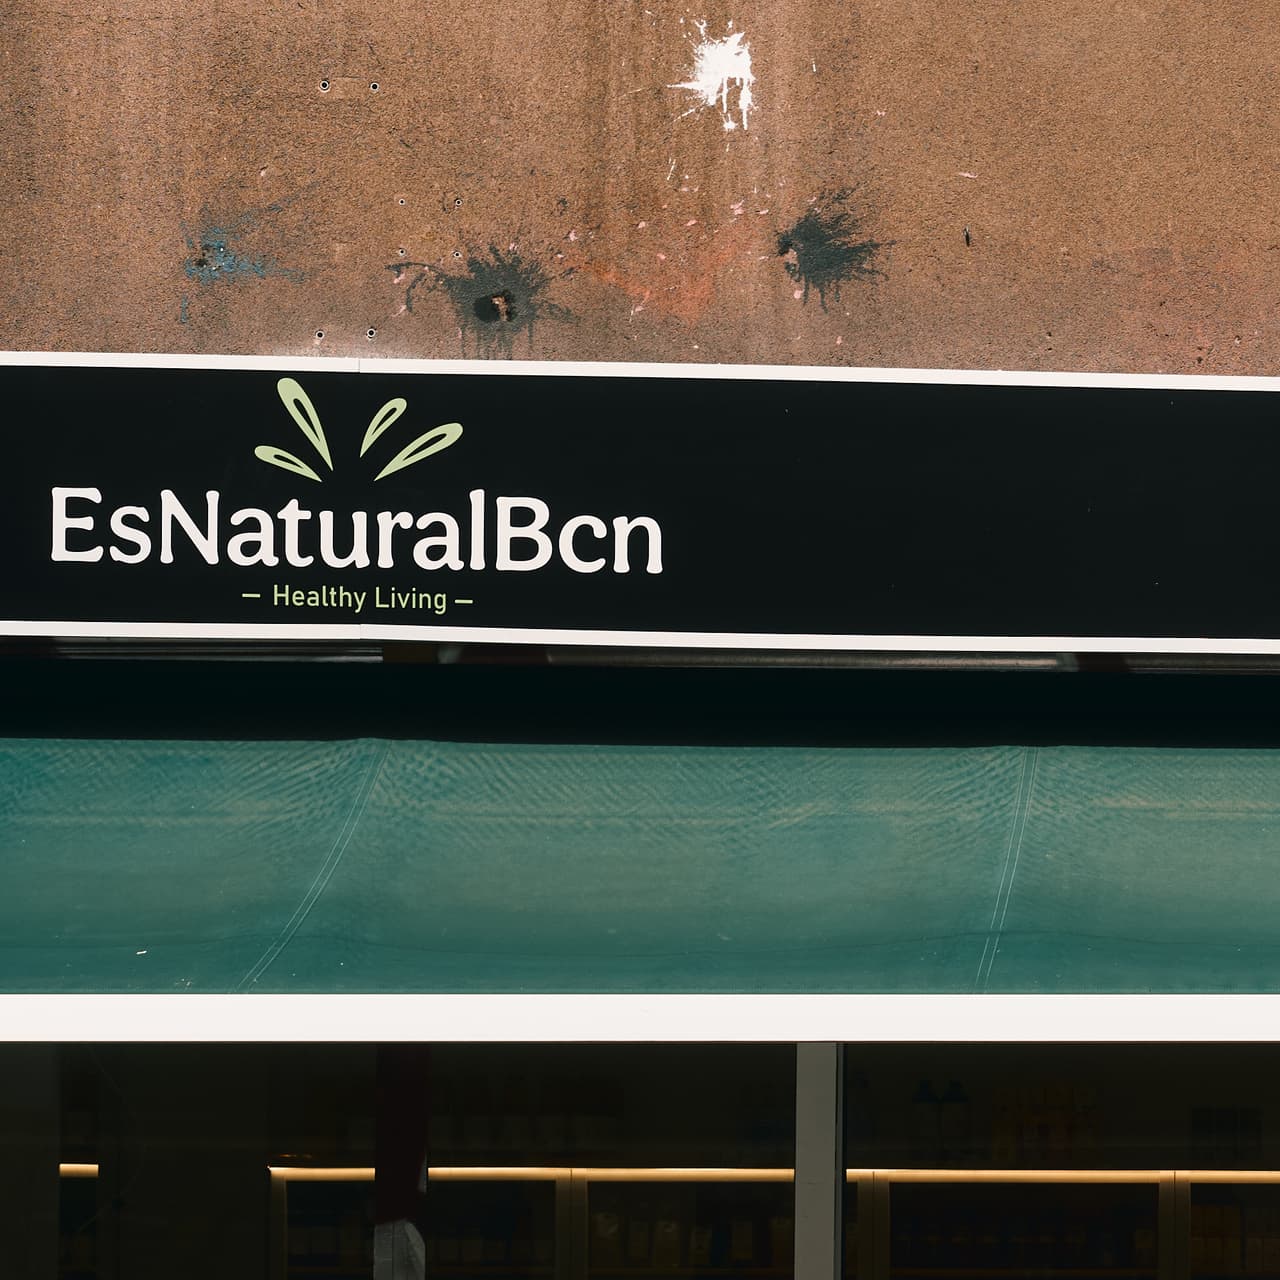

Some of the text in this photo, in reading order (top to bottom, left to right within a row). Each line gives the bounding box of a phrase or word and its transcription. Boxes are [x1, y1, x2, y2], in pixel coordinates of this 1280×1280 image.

[50, 487, 663, 575] EsNaturalBcn
[272, 584, 448, 615] Healthy Living
